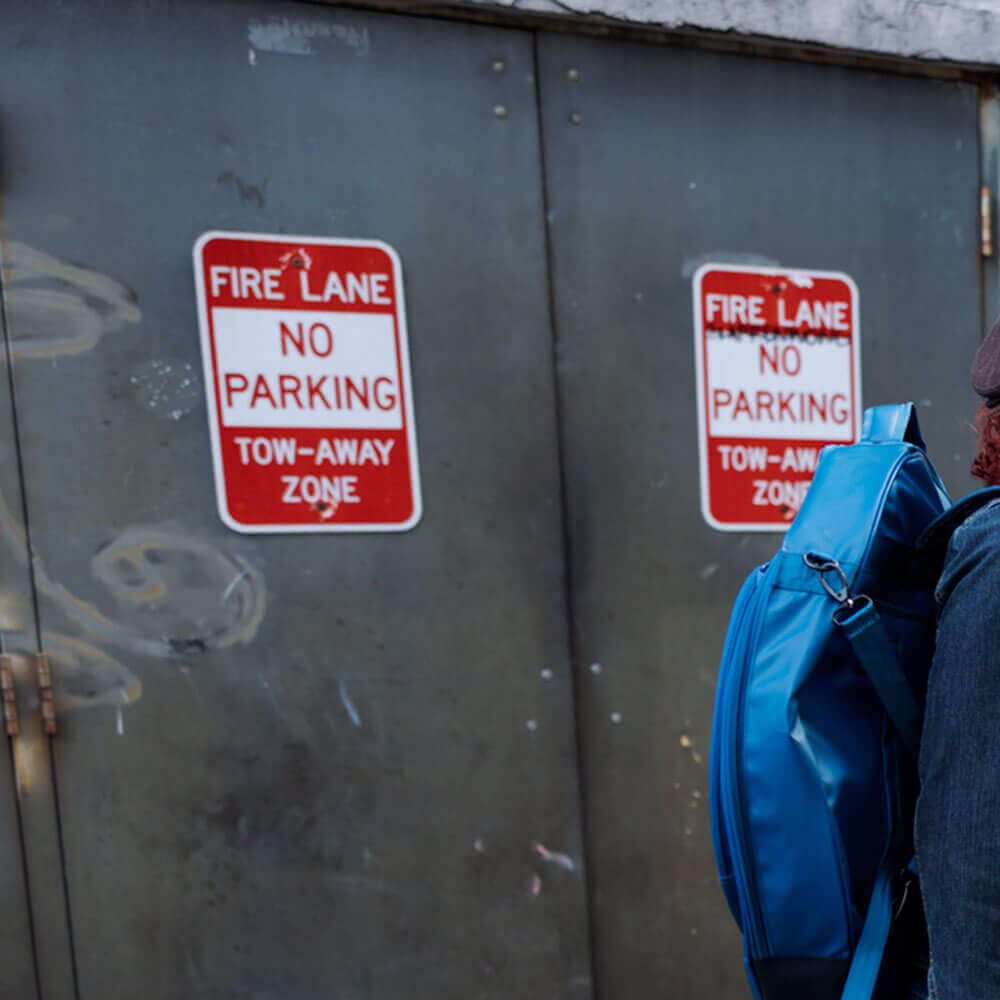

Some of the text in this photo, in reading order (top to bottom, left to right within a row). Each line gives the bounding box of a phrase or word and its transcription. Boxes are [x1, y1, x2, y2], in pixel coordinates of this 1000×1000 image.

[209, 265, 393, 305] FIRE LANE
[705, 293, 850, 331] FIRE LANE
[279, 321, 333, 358] NO
[759, 344, 802, 376] NO
[223, 373, 396, 411] PARKING
[713, 388, 849, 425] PARKING
[233, 436, 396, 466] TOW-AWAY
[717, 445, 819, 472] TOW-AW
[281, 475, 360, 504] ZONE
